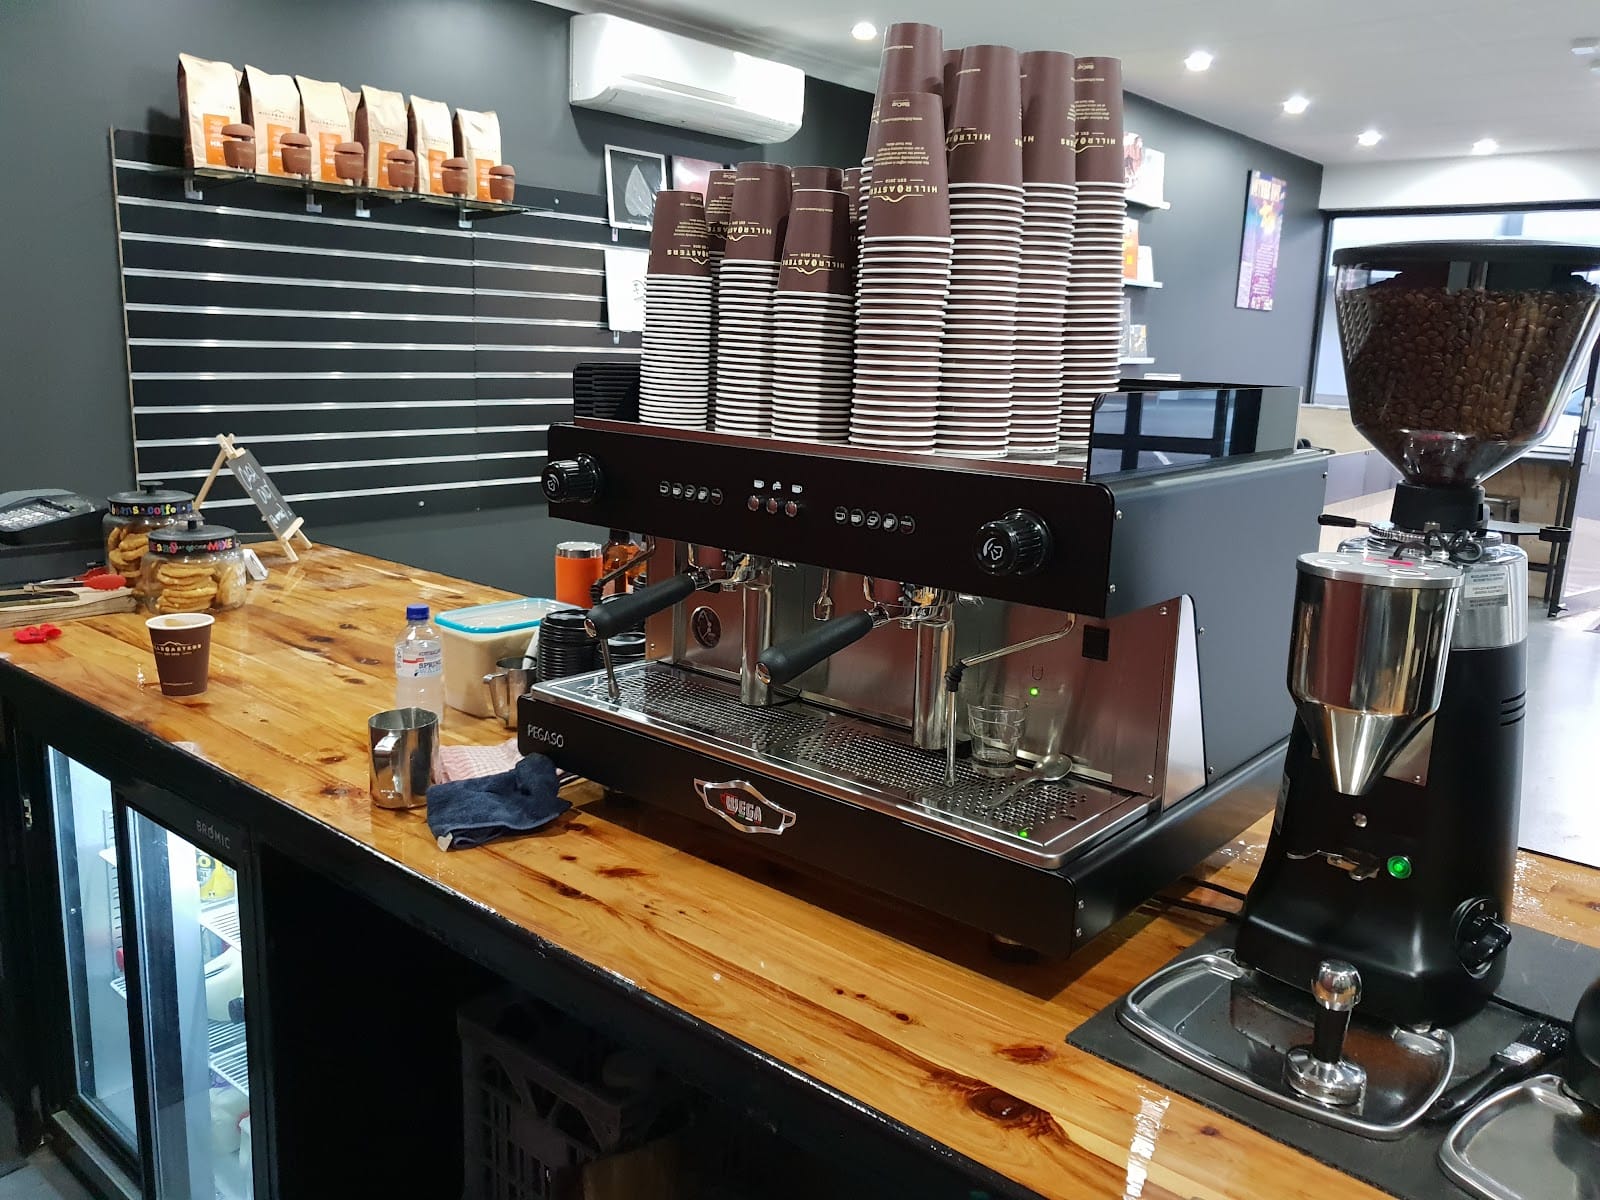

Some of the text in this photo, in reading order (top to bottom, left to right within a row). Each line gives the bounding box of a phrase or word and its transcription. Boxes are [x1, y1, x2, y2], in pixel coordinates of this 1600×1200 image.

[527, 724, 565, 748] PEGASO
[725, 794, 763, 823] WEGA
[195, 819, 232, 849] BROMIC
